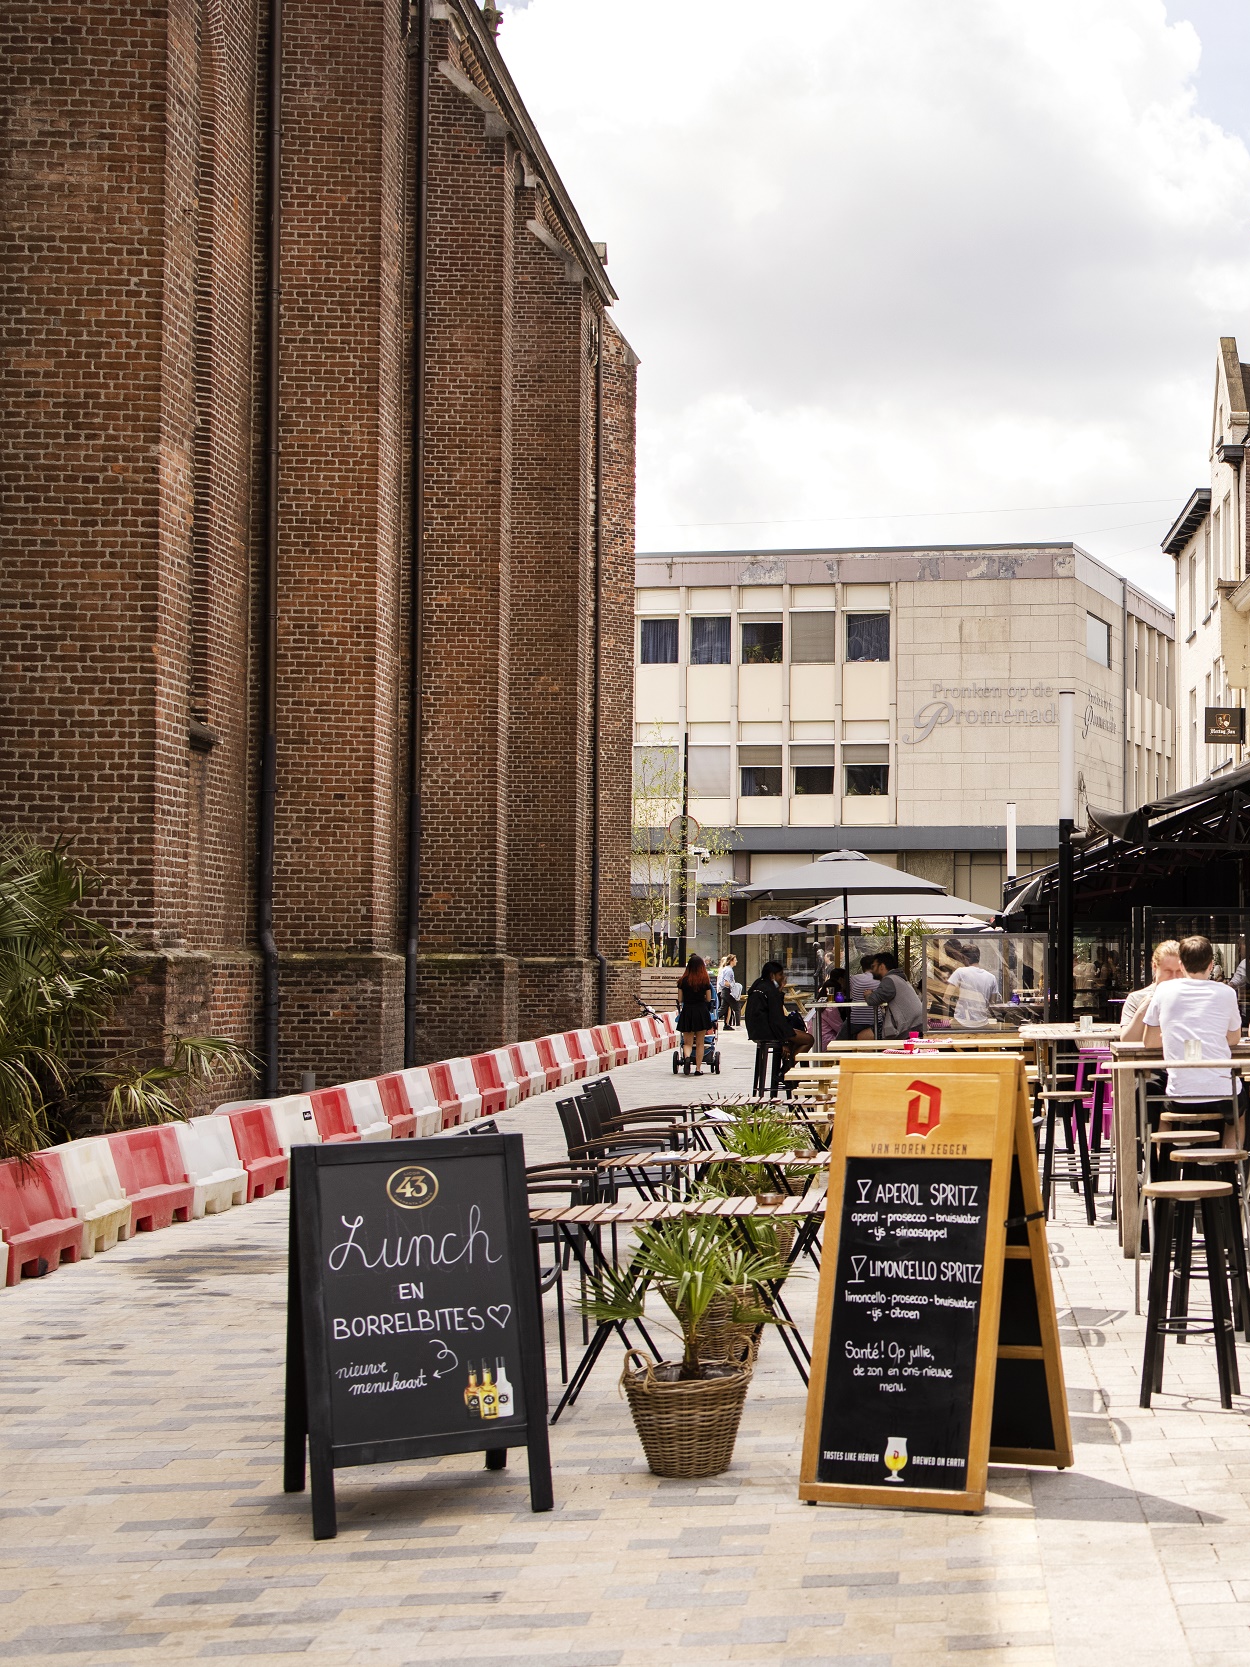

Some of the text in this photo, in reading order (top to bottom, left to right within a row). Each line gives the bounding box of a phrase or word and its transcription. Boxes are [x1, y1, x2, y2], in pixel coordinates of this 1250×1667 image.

[931, 682, 1054, 701] Pronken op de
[902, 700, 1060, 745] Promenad
[871, 1143, 967, 1156] VAN HOREN ZEGGEN
[395, 1175, 428, 1198] 43
[875, 1183, 979, 1207] APEROL SPRITZ
[851, 1211, 879, 1226] aperol
[329, 1205, 503, 1271] Lunch
[869, 1260, 983, 1285] LIMONCELLO SPRITZ
[398, 1282, 425, 1300] EN
[845, 1290, 886, 1305] limoncello
[333, 1306, 486, 1340] BORRELBITES
[845, 1340, 885, 1359] Santé!
[888, 1342, 906, 1364] Op
[336, 1361, 389, 1379] nieuwe
[853, 1364, 866, 1377] de
[867, 1367, 884, 1377] zon
[887, 1367, 900, 1376] en
[922, 1365, 954, 1378] nieuwe
[348, 1369, 428, 1396] menukaart
[879, 1382, 907, 1393] menu.
[823, 1450, 880, 1463] TASTES LIKE HEAVEN
[912, 1455, 966, 1468] BREWED ON EARTH
